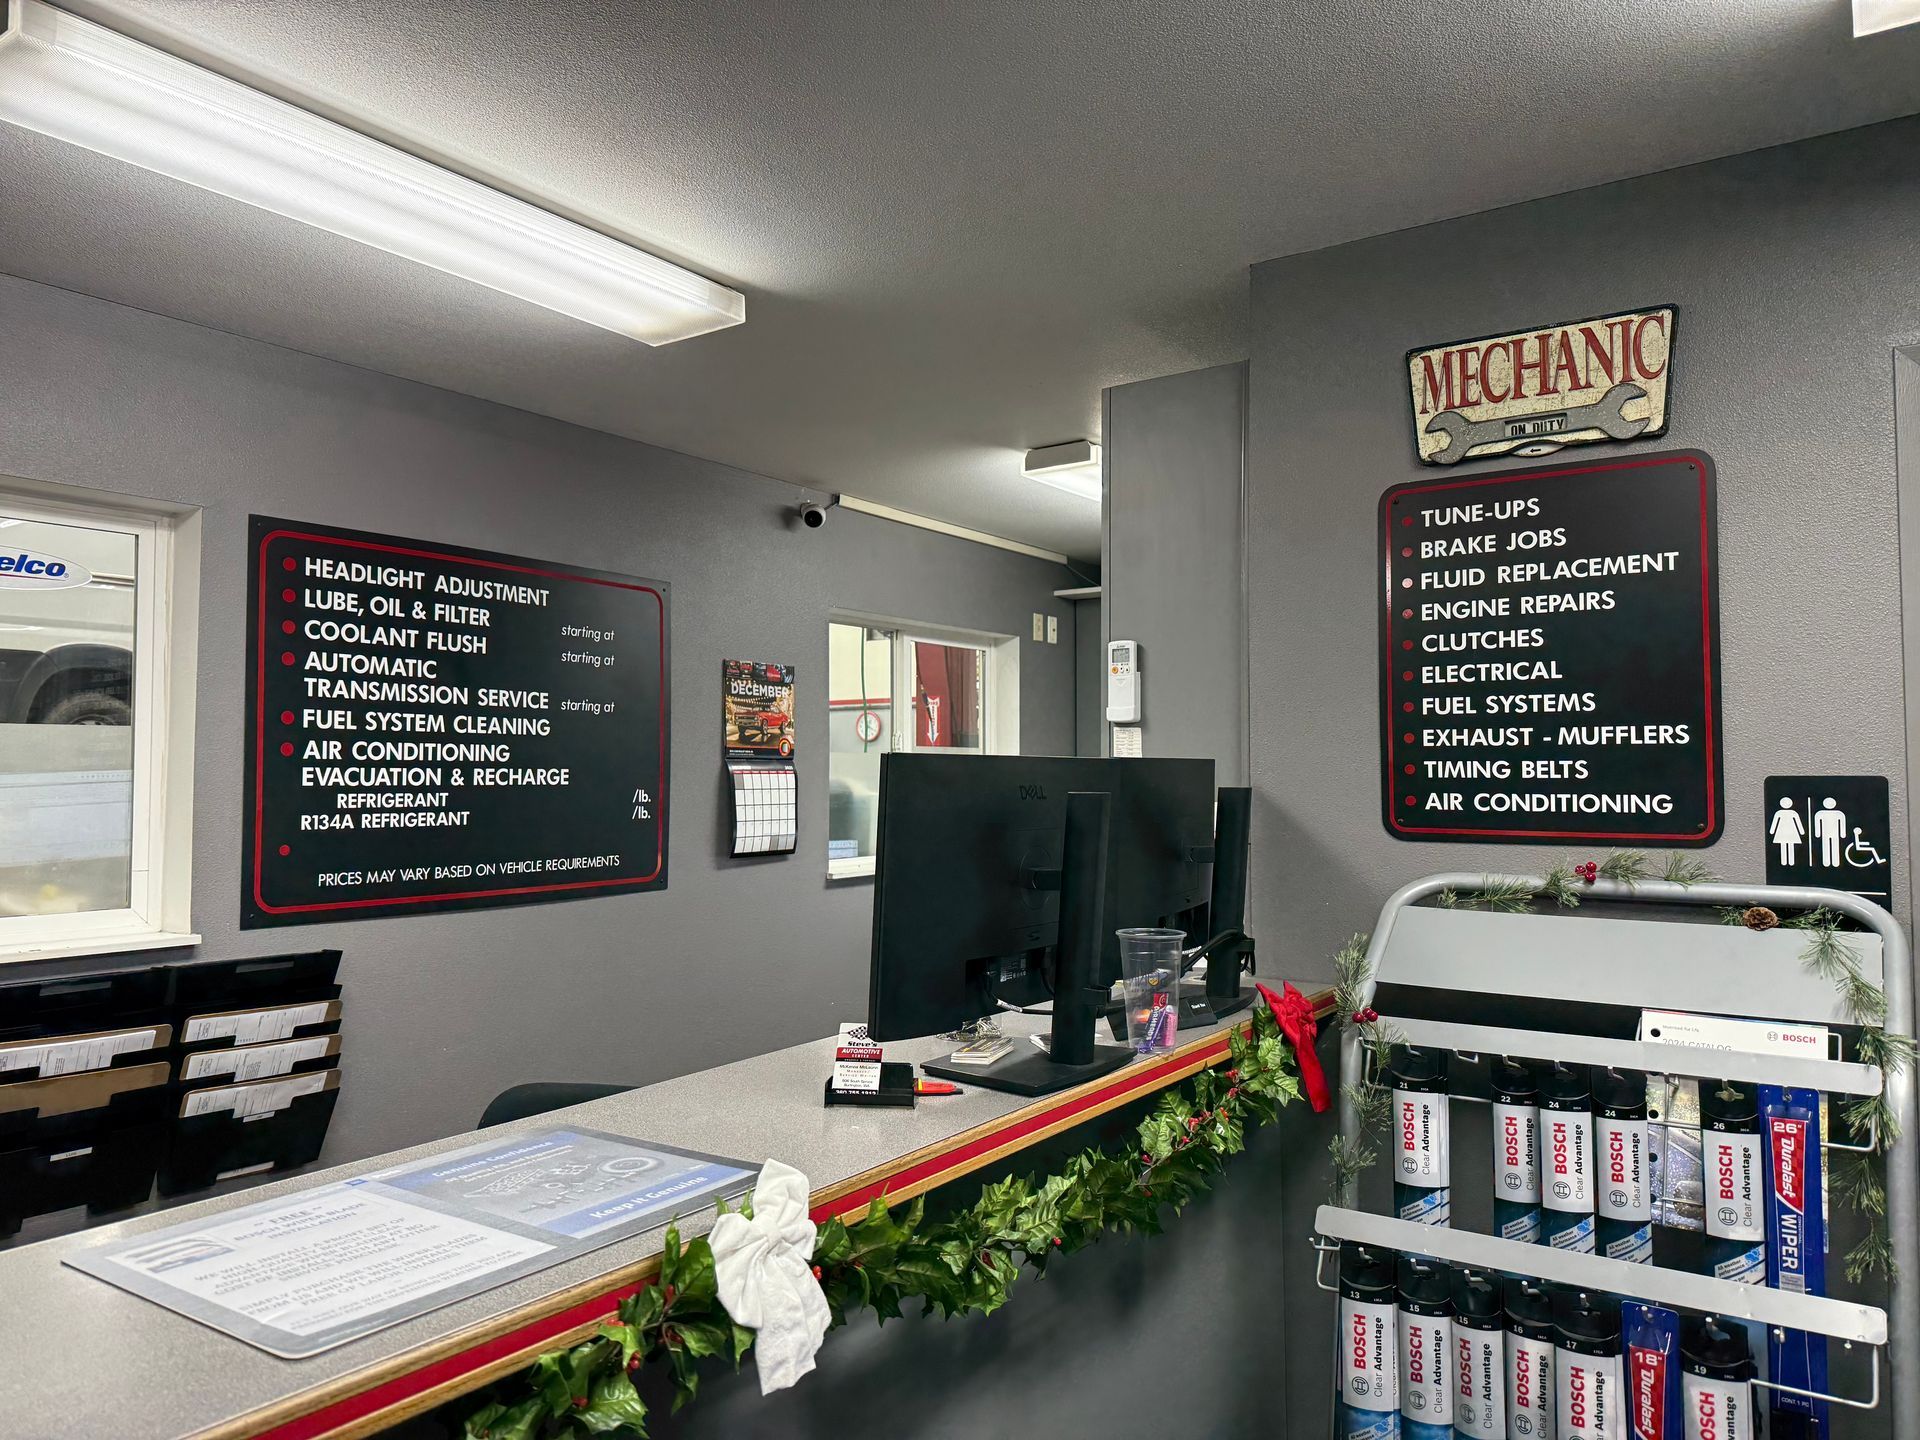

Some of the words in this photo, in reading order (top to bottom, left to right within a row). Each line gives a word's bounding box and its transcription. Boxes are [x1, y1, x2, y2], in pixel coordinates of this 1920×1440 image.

[1420, 314, 1666, 414] MECHANIC
[1511, 422, 1526, 435] ON
[1532, 419, 1564, 433] DUTY
[1422, 498, 1540, 527] TUNE-UPS
[1420, 535, 1497, 559] BRAKE
[1506, 528, 1567, 552] JOBS
[305, 557, 425, 590] HEADLIGHT
[434, 575, 549, 606] ADJUSTMENT
[1420, 568, 1485, 590] FLUID
[1497, 552, 1679, 583] REPLACEMENT
[305, 589, 364, 616] LUBE,
[370, 596, 405, 619] OIL
[412, 602, 426, 620] &
[434, 604, 490, 626] FILTER
[1421, 599, 1510, 621] ENGINE
[1521, 590, 1615, 614] REPAIRS
[304, 620, 418, 648] COOLANT
[427, 632, 487, 654] FLUSH
[561, 624, 600, 642] starting
[604, 629, 614, 640] at
[1422, 628, 1544, 652] CLUTCHES
[305, 652, 437, 679] AUTOMATIC
[561, 651, 600, 667] starting
[604, 655, 614, 666] at
[1422, 661, 1562, 684] ELECTRICAL
[304, 678, 468, 705] TRANSMISSION
[478, 689, 549, 709] SERVICE
[561, 699, 600, 715] starting
[604, 702, 614, 713] at
[731, 683, 788, 698] DECEMBER
[1422, 697, 1476, 715] FUEL
[1486, 692, 1595, 714] SYSTEMS
[303, 709, 357, 730] FUEL
[365, 712, 445, 733] SYSTEM
[453, 716, 550, 736] CLEANING
[1422, 727, 1533, 746] EXHAUST
[1558, 725, 1689, 745] MUFFLERS
[303, 741, 342, 760] AIR
[353, 741, 510, 762] CONDITIONING
[302, 767, 442, 787] EVACUATION
[451, 768, 464, 786] &
[473, 769, 569, 786] RECHARGE
[1424, 761, 1510, 779] TIMING
[1522, 760, 1588, 779] BELTS
[337, 792, 448, 808] REFRIGERANT
[1019, 784, 1047, 800] DELL
[1425, 792, 1463, 811] AIR
[1473, 793, 1673, 814] CONDITIONING
[301, 812, 354, 830] R134A
[361, 811, 470, 828] REFRIGERANT
[318, 872, 363, 887] PRICES
[366, 868, 396, 884] MAY
[400, 867, 430, 882] VARY
[434, 864, 472, 879] BASED
[476, 863, 496, 877] ON
[499, 860, 542, 875] VEHICLE
[545, 855, 620, 872] REQUIREMENTS
[1783, 1034, 1816, 1044] BOSCH
[1403, 1102, 1414, 1151] BOSCH
[1422, 1104, 1430, 1152] Advantage
[1505, 1117, 1518, 1166] BOSCH
[1526, 1118, 1534, 1166] Advantage
[1553, 1123, 1567, 1174] BOSCH
[1575, 1125, 1583, 1174] Advantage
[1610, 1131, 1624, 1183] BOSCH
[1632, 1133, 1640, 1183] Advantage
[1526, 1168, 1534, 1190] Clear
[1719, 1145, 1734, 1199] BOSCH
[1742, 1147, 1752, 1200] Advantage
[1781, 1137, 1796, 1199] Duralast
[591, 1201, 634, 1218] Keep
[631, 1196, 648, 1204] It
[645, 1175, 708, 1198] Genuine
[1743, 1203, 1751, 1227] Clear
[1781, 1214, 1798, 1270] WIPER
[1410, 1304, 1419, 1312] 15
[1459, 1316, 1468, 1324] 15
[1354, 1314, 1366, 1369] BOSCH
[1374, 1317, 1383, 1370] Advantage
[1513, 1325, 1523, 1333] 16
[1410, 1326, 1423, 1383] BOSCH
[1433, 1330, 1442, 1385] Advantage
[1566, 1341, 1577, 1349] 17
[1460, 1338, 1472, 1397] BOSCH
[1482, 1344, 1492, 1401] Advantage
[1517, 1349, 1529, 1408] BOSCH
[1537, 1355, 1548, 1411] Advantage
[1694, 1365, 1706, 1374] 19
[1374, 1371, 1382, 1397] Clear
[1571, 1366, 1585, 1428] BOSCH
[1434, 1388, 1442, 1413] Clear
[1484, 1403, 1492, 1428] Clear
[1594, 1371, 1605, 1430] Advantage
[1641, 1369, 1655, 1434] Duralast
[1537, 1413, 1547, 1438] Clear
